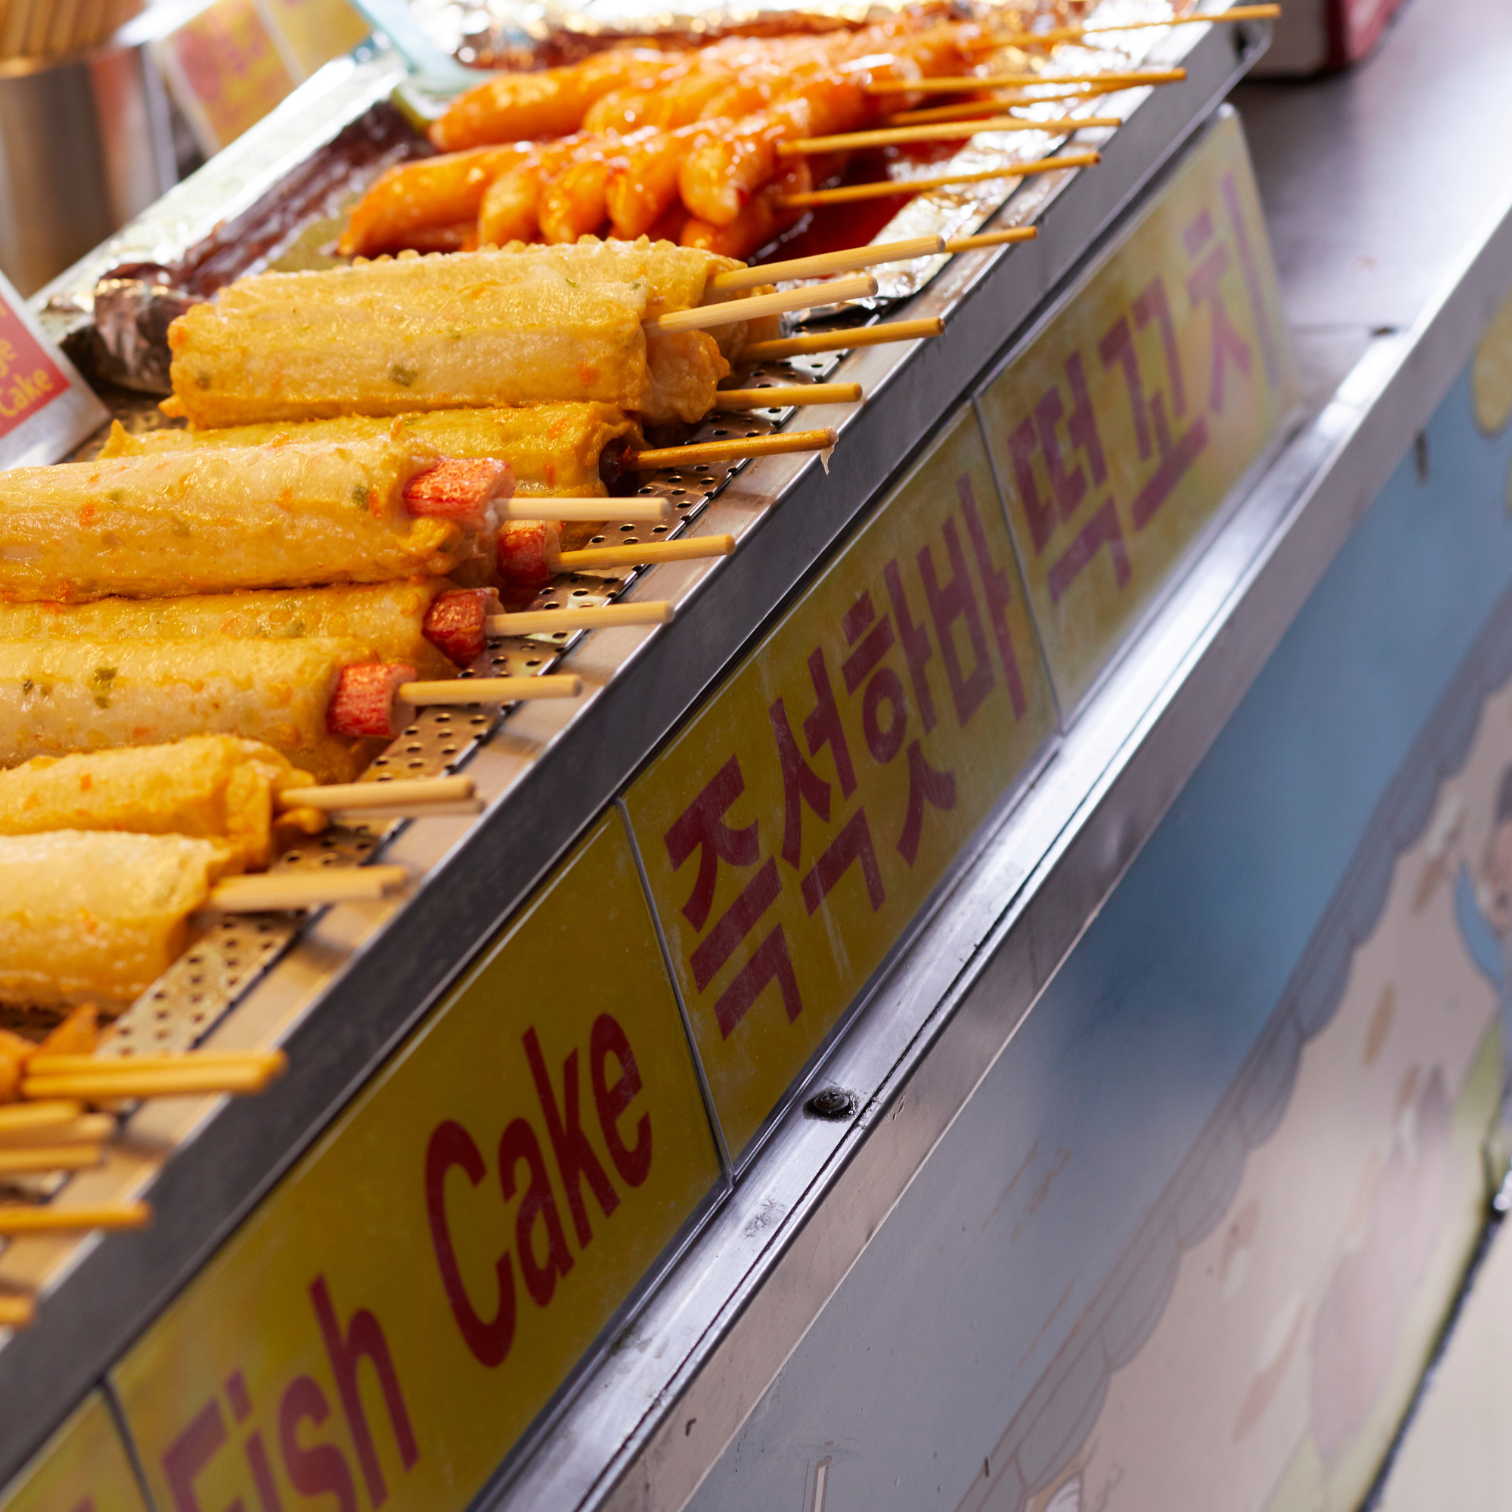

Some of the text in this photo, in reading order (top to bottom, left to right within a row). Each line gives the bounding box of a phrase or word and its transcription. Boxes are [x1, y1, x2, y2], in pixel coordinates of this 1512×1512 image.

[1007, 170, 1281, 603] 떡꼬치
[664, 472, 1028, 1042] 즉석핫바
[424, 1013, 653, 1369] Cake
